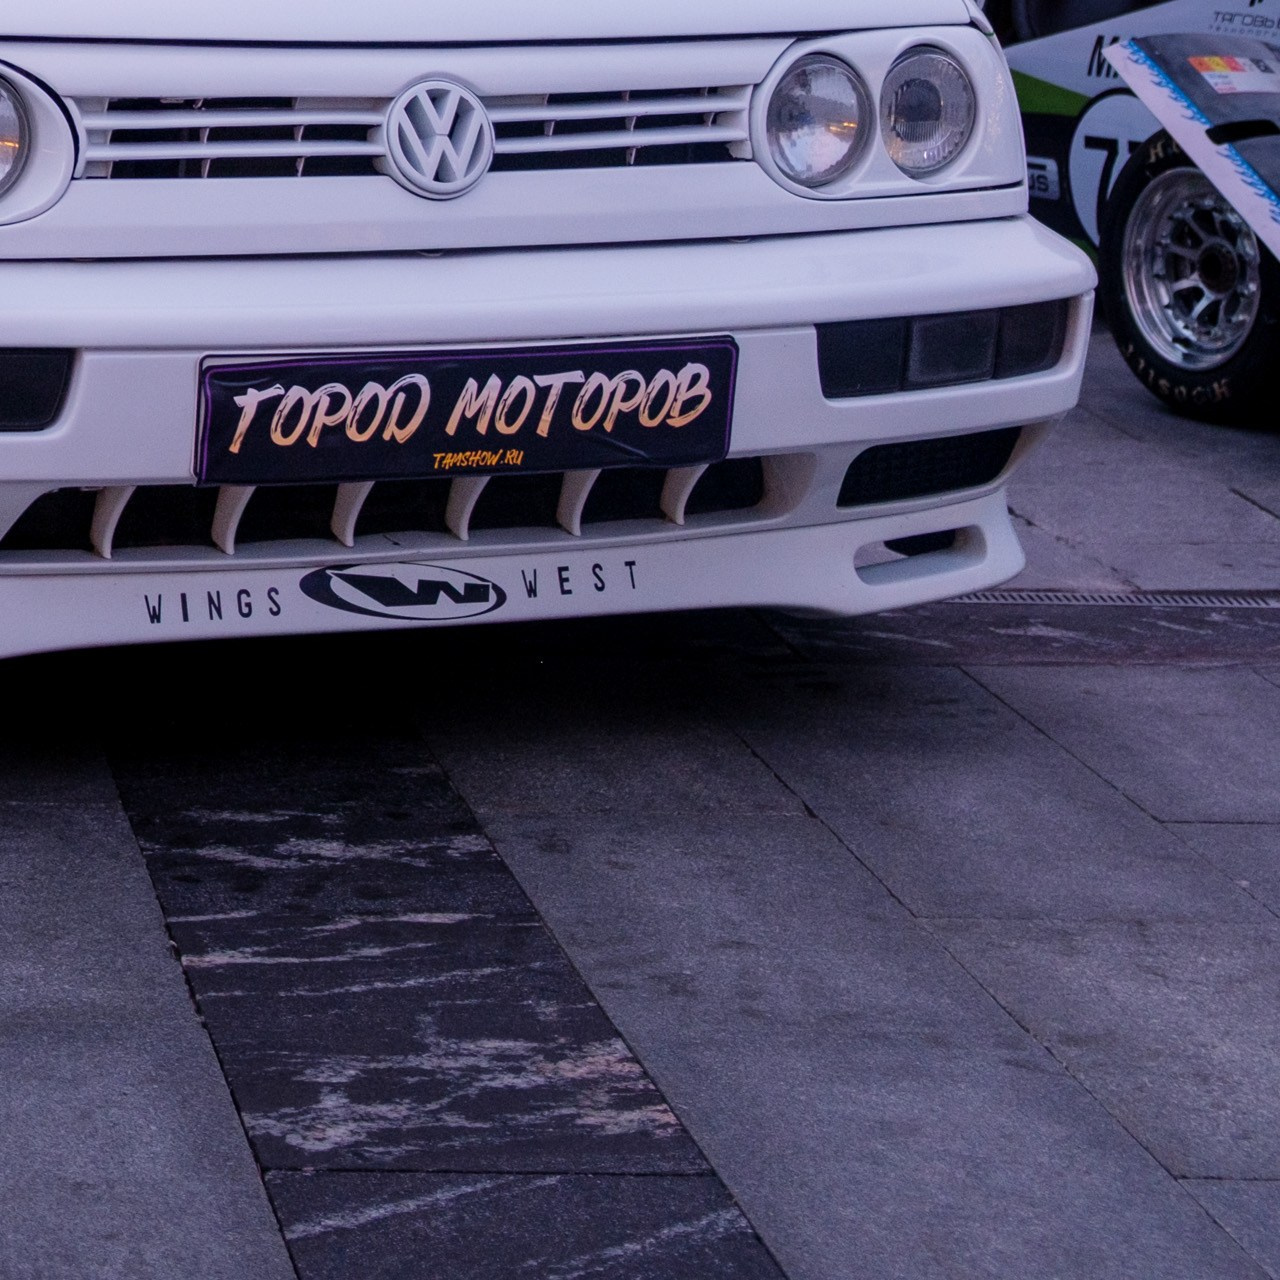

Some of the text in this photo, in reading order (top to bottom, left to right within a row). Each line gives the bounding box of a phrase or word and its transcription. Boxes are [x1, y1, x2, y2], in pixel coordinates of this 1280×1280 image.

[432, 449, 524, 470] TAMSHOW.RU
[145, 587, 282, 624] WINGS
[521, 560, 638, 599] WEST
